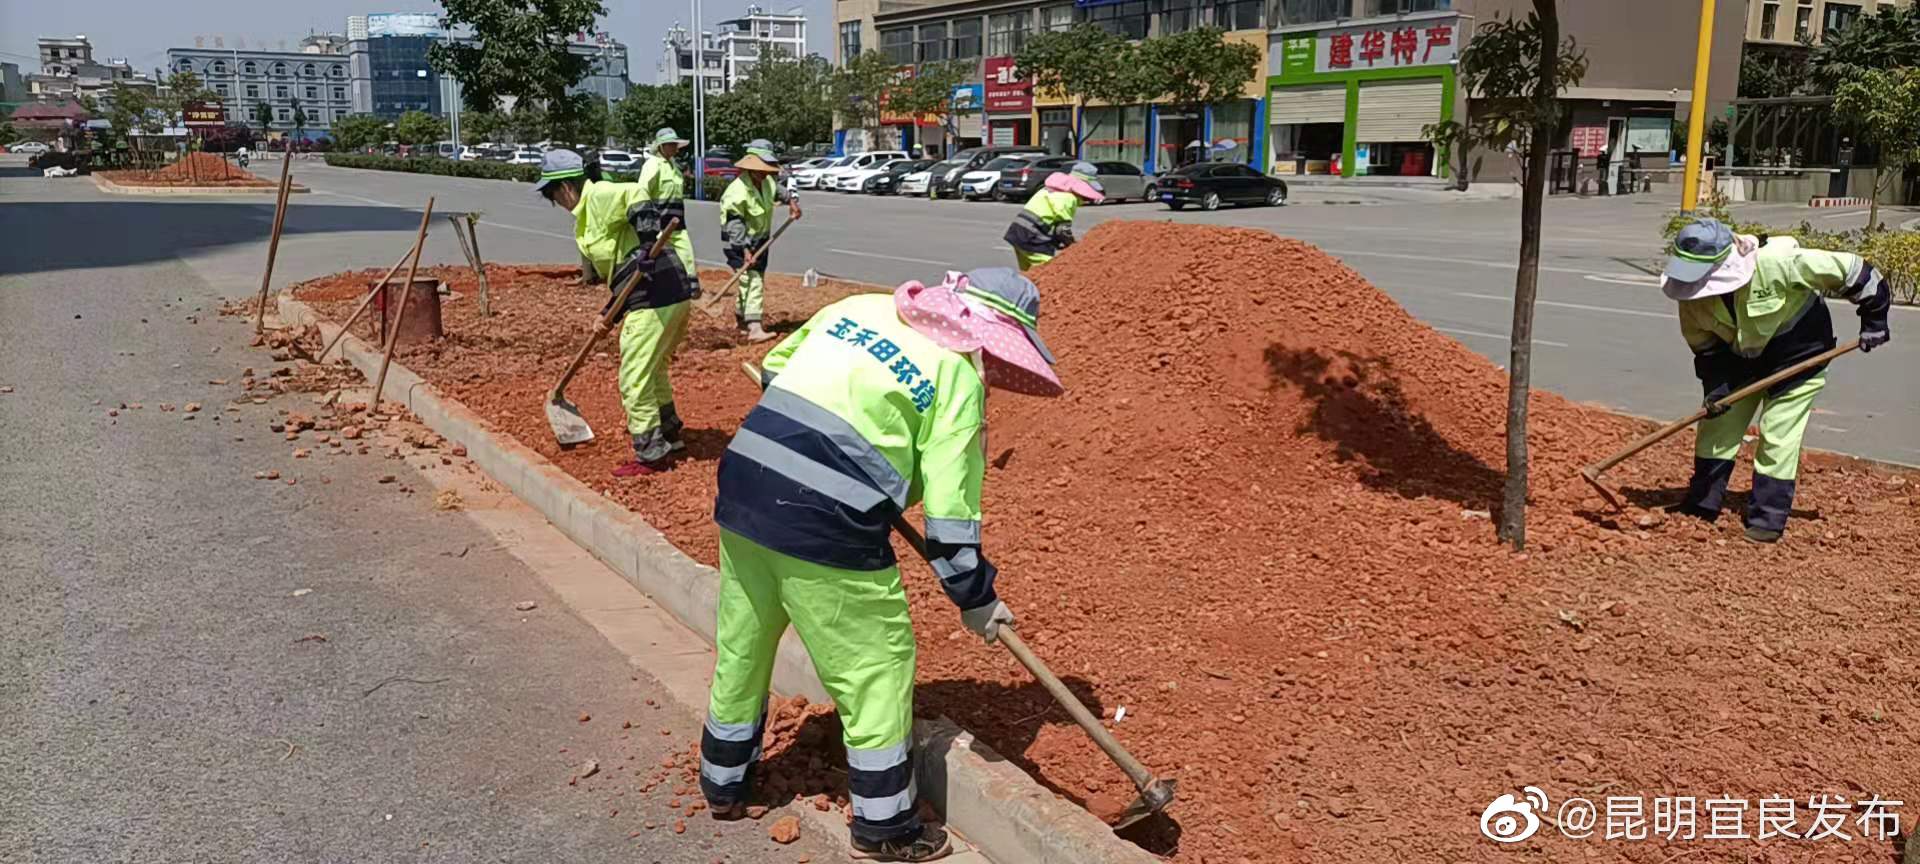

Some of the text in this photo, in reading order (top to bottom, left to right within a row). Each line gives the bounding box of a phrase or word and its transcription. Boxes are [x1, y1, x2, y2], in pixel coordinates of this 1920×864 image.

[1328, 24, 1452, 69] 建华特产
[826, 317, 936, 413] 玉禾田环境
